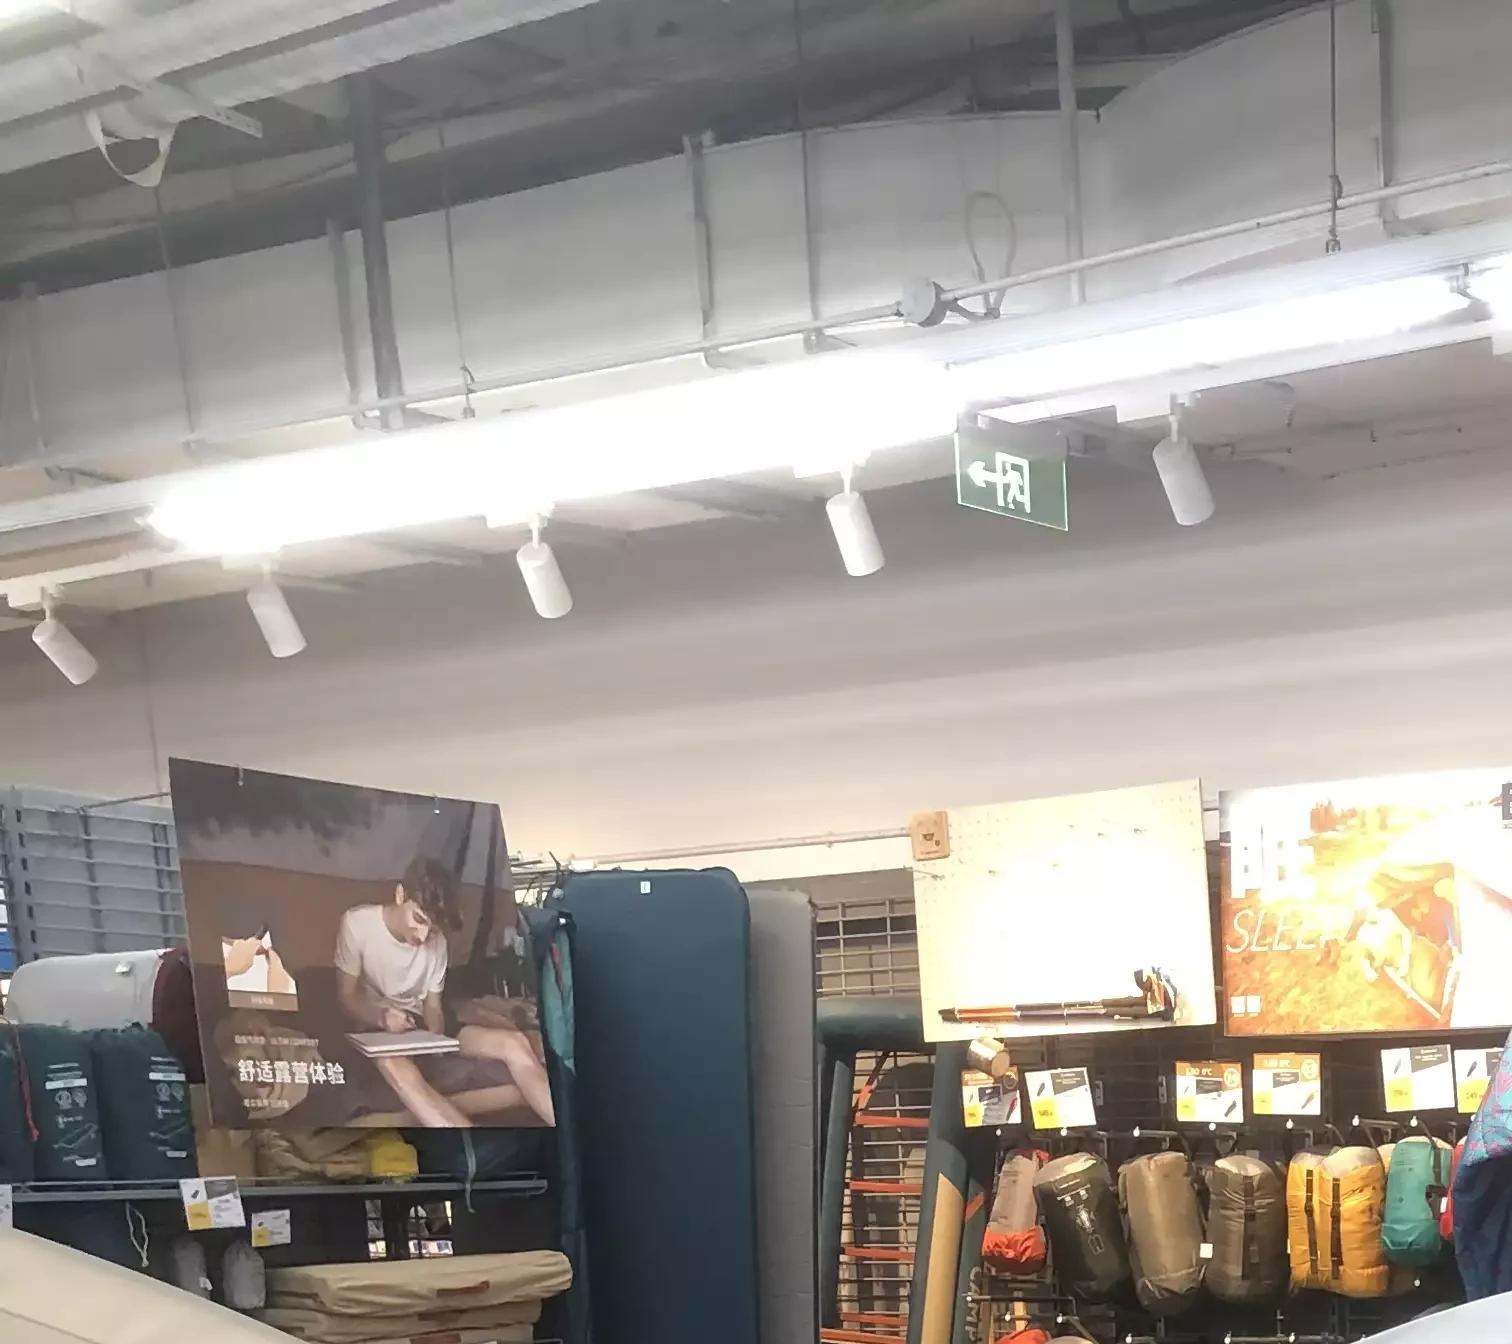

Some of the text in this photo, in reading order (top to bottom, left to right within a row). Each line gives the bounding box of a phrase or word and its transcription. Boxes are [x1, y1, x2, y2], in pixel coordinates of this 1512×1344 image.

[238, 1059, 346, 1085] 舒适露营体验
